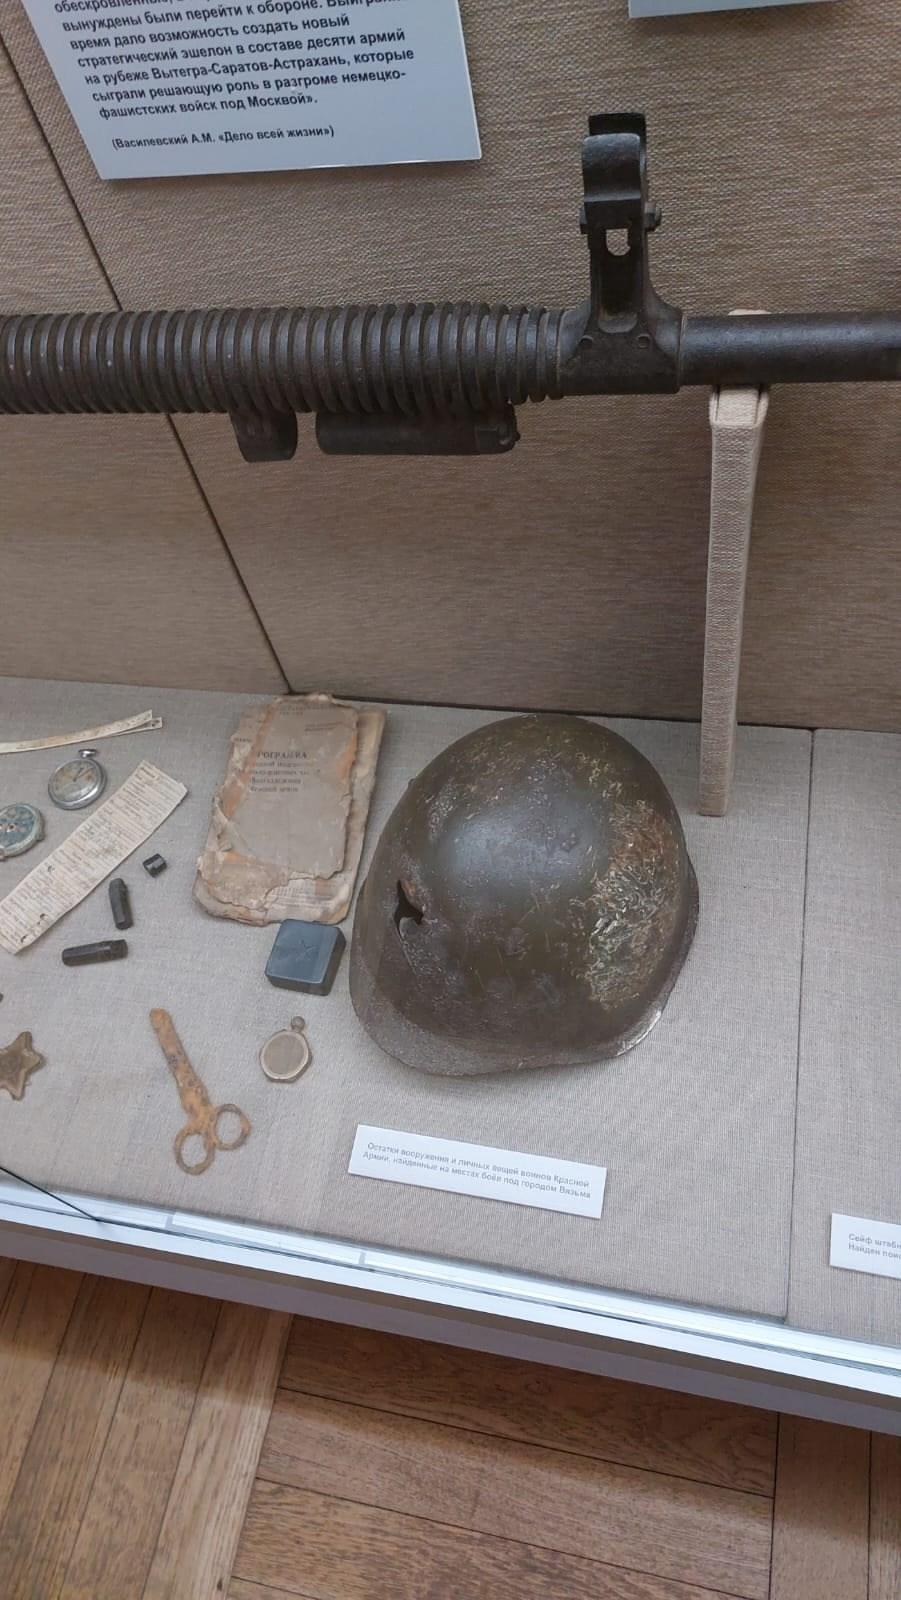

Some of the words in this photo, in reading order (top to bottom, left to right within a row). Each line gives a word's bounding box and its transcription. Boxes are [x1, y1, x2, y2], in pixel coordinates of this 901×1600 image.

[62, 14, 142, 32] вынуждены
[144, 10, 182, 24] были
[186, 4, 243, 21] перейти
[246, 5, 254, 15] к
[257, 0, 323, 15] обороне.
[70, 37, 110, 51] время
[114, 34, 146, 47] дало
[149, 26, 239, 43] возможность
[242, 21, 298, 35] создать
[302, 13, 350, 30] новый
[78, 48, 178, 69] стратегический
[181, 45, 232, 59] эшелон
[236, 45, 245, 54] в
[248, 39, 303, 54] составе
[307, 34, 356, 50] десяти
[359, 28, 405, 46] армий
[85, 74, 100, 85] на
[103, 69, 149, 86] рубеже
[151, 55, 351, 80] Вытегра-Саратов-Астрахань,
[354, 49, 414, 64] которые
[92, 88, 146, 102] сыграли
[149, 82, 223, 99] решающую
[226, 80, 259, 94] роль
[263, 80, 271, 89] в
[275, 73, 338, 91] разгроме
[342, 70, 406, 83] немецко-
[99, 103, 177, 120] фашистских
[179, 99, 217, 113] войск
[220, 99, 245, 110] под
[248, 93, 318, 108] Москвой».
[112, 134, 188, 151] (Василевский
[191, 132, 215, 145] А.М.
[218, 130, 253, 143] «Дело
[257, 128, 284, 140] всей
[287, 125, 334, 138] жизни»)
[363, 1151, 391, 1162] Армии,
[393, 1157, 438, 1170] найденные
[451, 1168, 479, 1178] местах
[504, 1176, 519, 1186] под
[521, 1180, 557, 1192] городом
[559, 1185, 591, 1199] Вязьма
[367, 1142, 399, 1154] Остатки
[401, 1148, 449, 1163] вооружения
[458, 1159, 490, 1170] личных
[492, 1164, 518, 1175] вещей
[521, 1170, 551, 1181] воинов
[553, 1174, 589, 1188] Красной
[848, 1243, 880, 1255] Найден
[849, 1233, 872, 1244] Сейф
